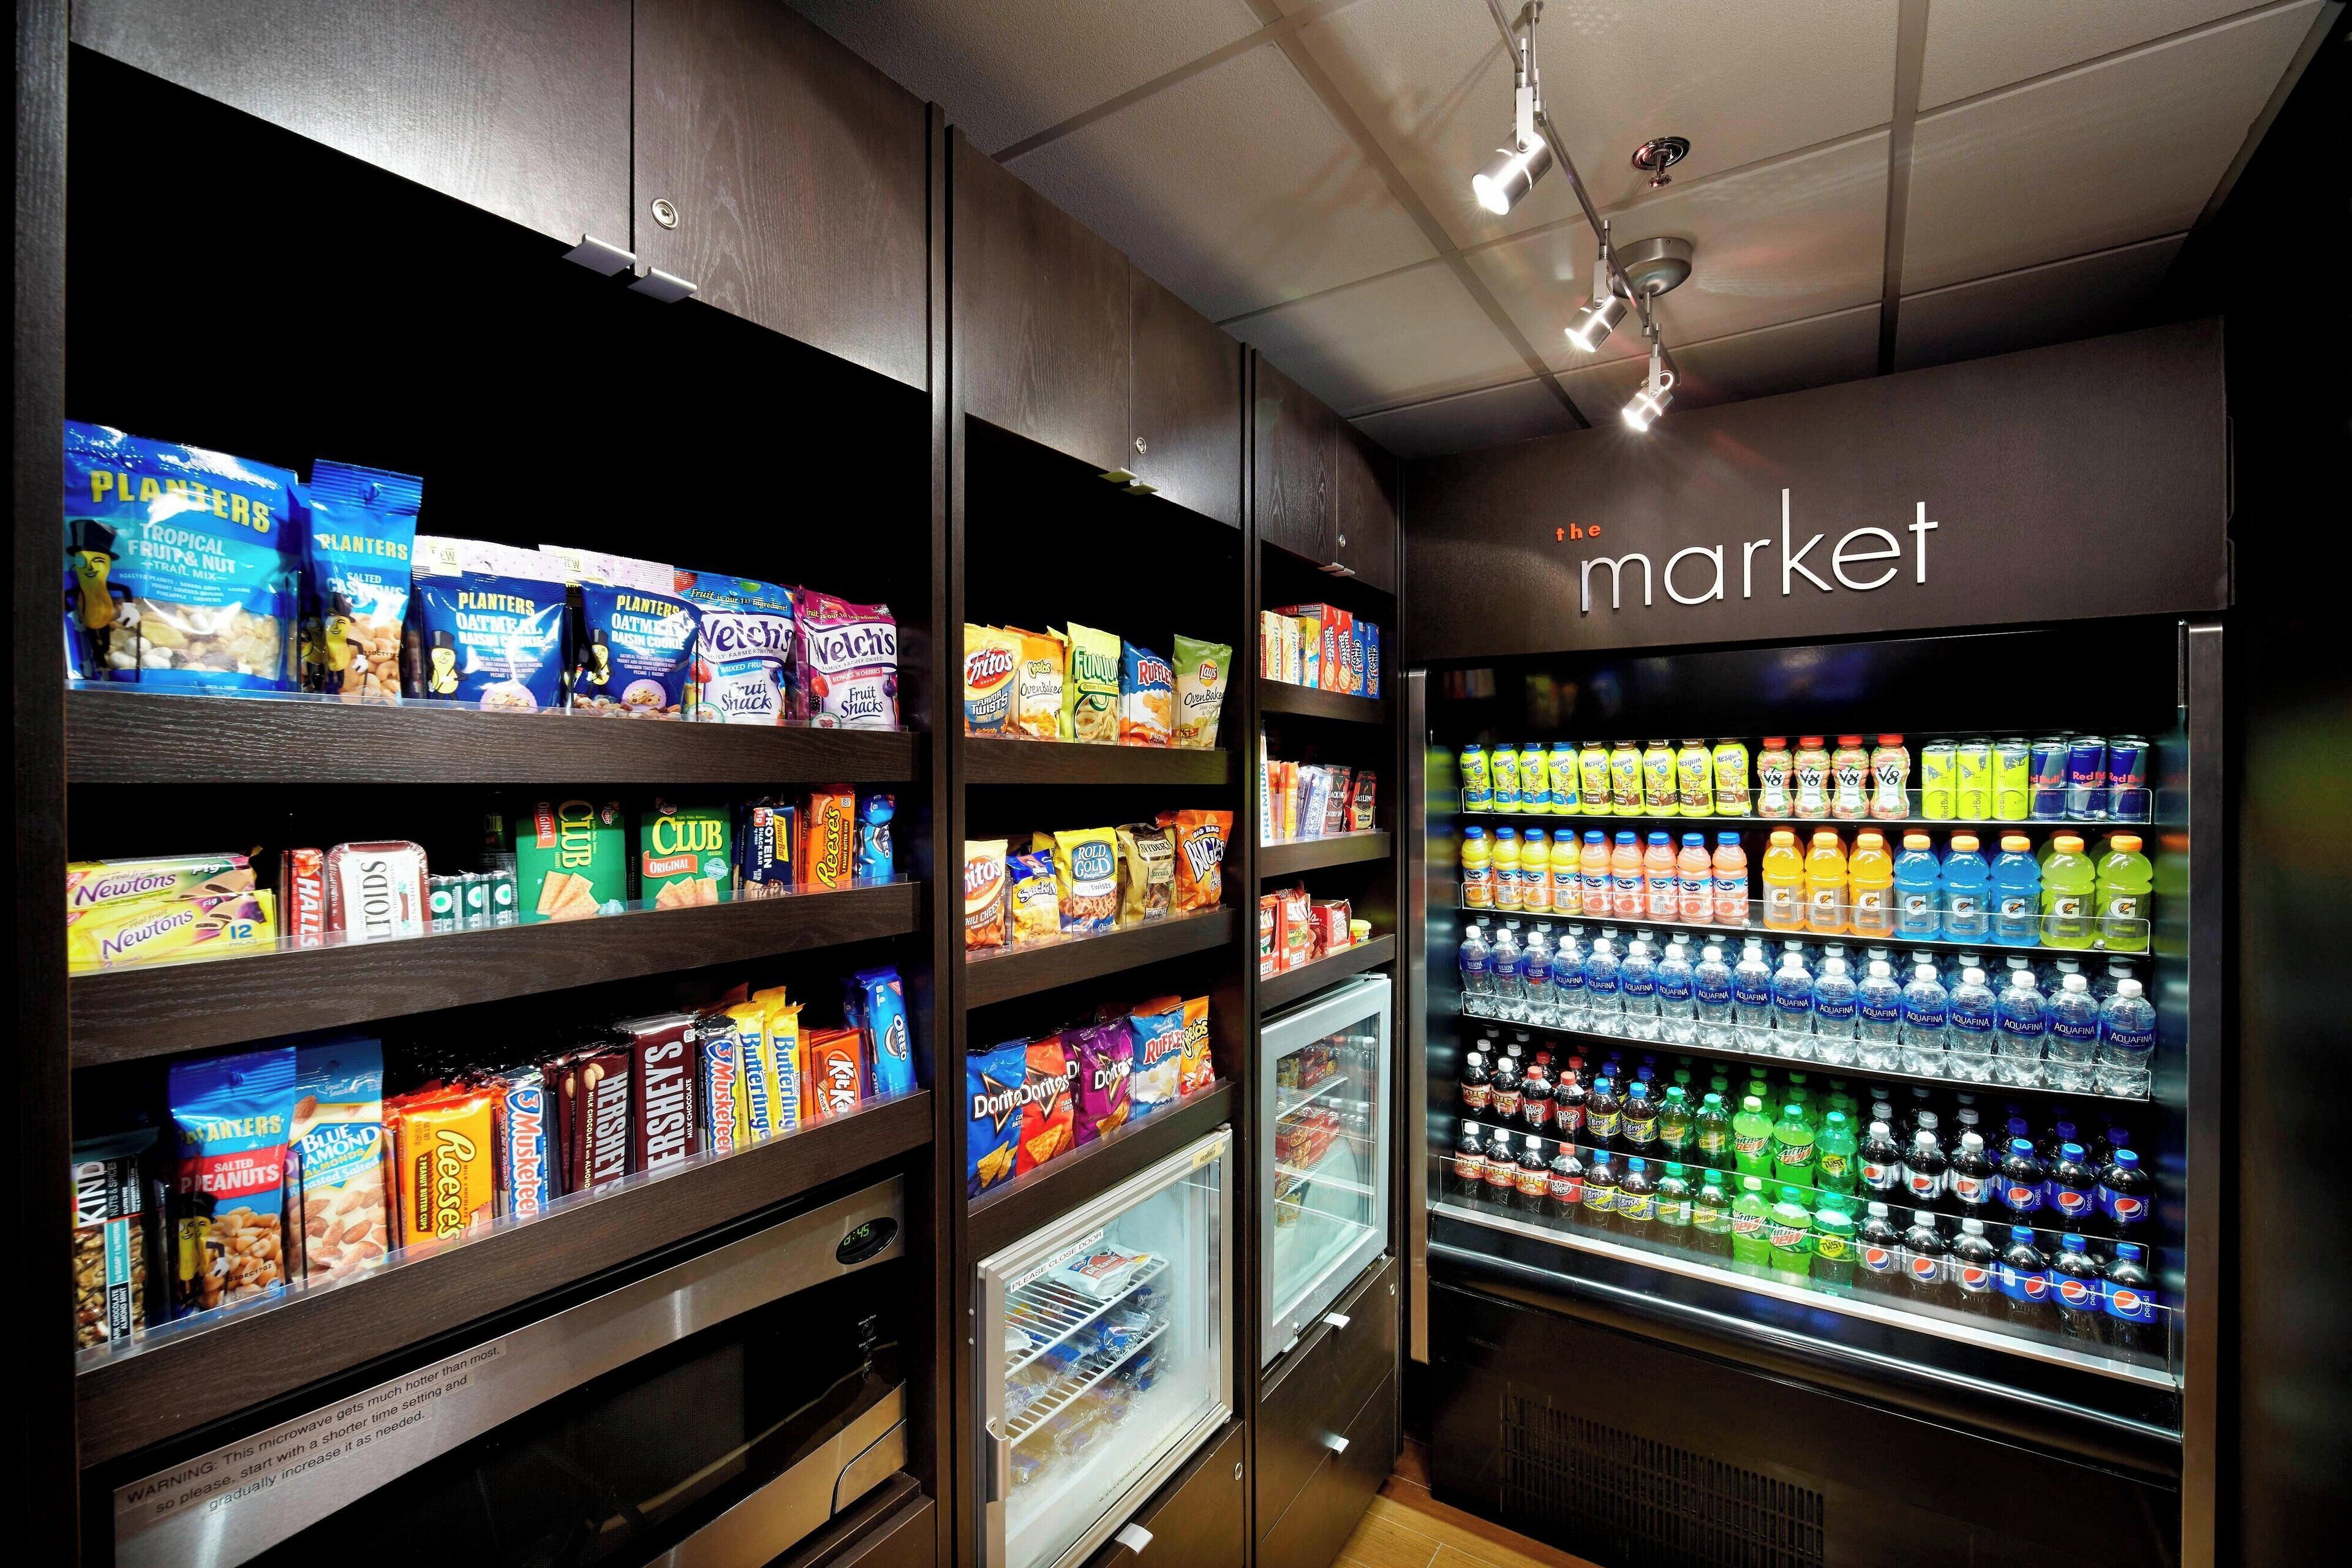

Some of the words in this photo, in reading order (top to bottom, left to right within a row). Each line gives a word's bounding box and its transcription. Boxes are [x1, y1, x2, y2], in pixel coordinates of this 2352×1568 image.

[91, 470, 271, 533] PLANTERS
[140, 523, 226, 556] TROPICAL
[1557, 523, 1601, 541] the
[318, 532, 409, 561] PLANTERS
[1581, 488, 1939, 612] market
[128, 539, 184, 564] FRUIT
[202, 554, 236, 574] NUT
[153, 560, 190, 576] TRAIL
[192, 570, 217, 581] MIX
[347, 571, 382, 584] SALTED
[458, 592, 535, 616] PLANTERS
[690, 589, 715, 600] Fruit
[752, 600, 788, 612] Ingredient!
[456, 612, 544, 635] OATMEAL
[611, 631, 646, 646] RAISIN
[647, 635, 685, 650] COOKIE
[699, 619, 794, 654] Welch's
[808, 627, 895, 666] Welch's
[721, 665, 745, 673] MIXED
[832, 673, 854, 682] BERRIES
[860, 668, 881, 677] CHERRIES
[965, 647, 1013, 687] Fritos
[1138, 659, 1174, 688] RUFFLES
[1200, 663, 1218, 681] Lay's
[728, 679, 767, 699] Fruit
[848, 685, 876, 703] Fruit
[977, 690, 1003, 706] FLAVOR
[1020, 682, 1041, 697] Oven
[840, 698, 884, 719] Snacks
[971, 692, 1009, 715] TWISTS
[1184, 692, 1206, 706] Oven
[975, 712, 992, 722] HONEY
[1460, 758, 1482, 769] Nesquik
[1493, 757, 1515, 768] Nesquik
[1585, 755, 1607, 768] Nesquik
[1716, 749, 1742, 763] Nesquik
[1763, 767, 1783, 786] V8
[1800, 767, 1820, 786] V8
[1839, 767, 1859, 786] V8
[2073, 771, 2094, 780] Red
[2109, 772, 2127, 783] Red
[1260, 763, 1270, 839] PREMIUM
[538, 802, 552, 840] ORIGINAL
[558, 800, 596, 869] CLUB
[652, 816, 724, 856] CLUB
[764, 808, 774, 869] PROTEIN
[775, 818, 785, 859] PowerBar
[1193, 829, 1205, 839] BIG
[1078, 844, 1107, 859] ROLD
[1139, 840, 1172, 853] SNYDER'S
[191, 862, 221, 875] Fig
[649, 858, 690, 874] ORIGINAL
[1075, 857, 1112, 878] GOLD
[1183, 837, 1226, 883] BUGLES
[75, 873, 176, 906] Newtons
[1090, 881, 1112, 891] twists
[202, 897, 218, 908] Fig
[1771, 888, 1790, 907] G
[1814, 890, 1834, 910] G
[1860, 892, 1880, 912] G
[1904, 895, 1927, 916] G
[146, 909, 167, 922] fruit
[296, 876, 320, 948] HALLS
[102, 910, 194, 957] Newtons
[230, 924, 253, 940] 12
[1556, 975, 1583, 985] AQUAFINA
[1588, 980, 1616, 990] AQUAFINA
[1624, 982, 1653, 992] AQUAFINA
[1659, 986, 1689, 997] AQUAFINA
[1698, 989, 1728, 1000] AQUAFINA
[1736, 990, 1768, 1001] AQUAFINA
[1776, 996, 1809, 1007] AQUAFINA
[1820, 1004, 1853, 1015] AQUAFINA
[892, 1013, 908, 1063] OREO
[1182, 1018, 1208, 1060] Cheetos
[716, 1043, 732, 1058] 3
[1142, 1030, 1183, 1066] RUFFLES
[1094, 1057, 1134, 1090] Doritos
[1019, 1073, 1070, 1105] Doritos
[1463, 1088, 1485, 1099] MUG
[517, 1093, 538, 1109] 3
[1524, 1106, 1544, 1115] Pepper
[1558, 1113, 1578, 1123] Pepper
[1591, 1117, 1610, 1126] Brisk
[594, 1071, 628, 1197] HERSHEY'S
[1627, 1123, 1648, 1133] Brisk
[1660, 1129, 1685, 1139] Schweppes
[302, 1123, 353, 1154] BLUE
[214, 1158, 254, 1172] SALTED
[304, 1148, 365, 1177] ALMONDS
[342, 1158, 380, 1179] Salted
[1823, 1158, 1844, 1168] TWIST
[107, 1161, 117, 1188] SPICES
[194, 1164, 280, 1193] PEANUTS
[1518, 1175, 1542, 1188] MUG
[77, 1161, 108, 1227] KIND
[1586, 1189, 1607, 1199] Brisk
[108, 1194, 119, 1216] NUTS
[1820, 1240, 1843, 1251] TWIST
[1012, 1267, 1047, 1291] PLEASE
[1049, 1247, 1077, 1268] CLOSE
[1079, 1232, 1102, 1251] DOOR
[127, 1460, 218, 1506] WARNING:
[222, 1446, 254, 1467] This
[258, 1414, 333, 1453] microwave
[336, 1402, 364, 1422] gets
[368, 1385, 402, 1408] much
[405, 1370, 440, 1393] hotter
[441, 1359, 468, 1378] than
[470, 1347, 501, 1366] most,
[156, 1501, 175, 1515] so
[179, 1475, 236, 1507] please,
[239, 1458, 273, 1479] start
[275, 1444, 306, 1465] with
[309, 1439, 318, 1450] a
[322, 1417, 369, 1446] shorter
[370, 1404, 399, 1425] time
[401, 1386, 442, 1411] setting
[445, 1374, 468, 1392] and
[208, 1473, 277, 1512] gradually
[281, 1449, 341, 1480] increase
[344, 1440, 353, 1453] it
[356, 1434, 372, 1448] as
[374, 1410, 426, 1440] needed.
